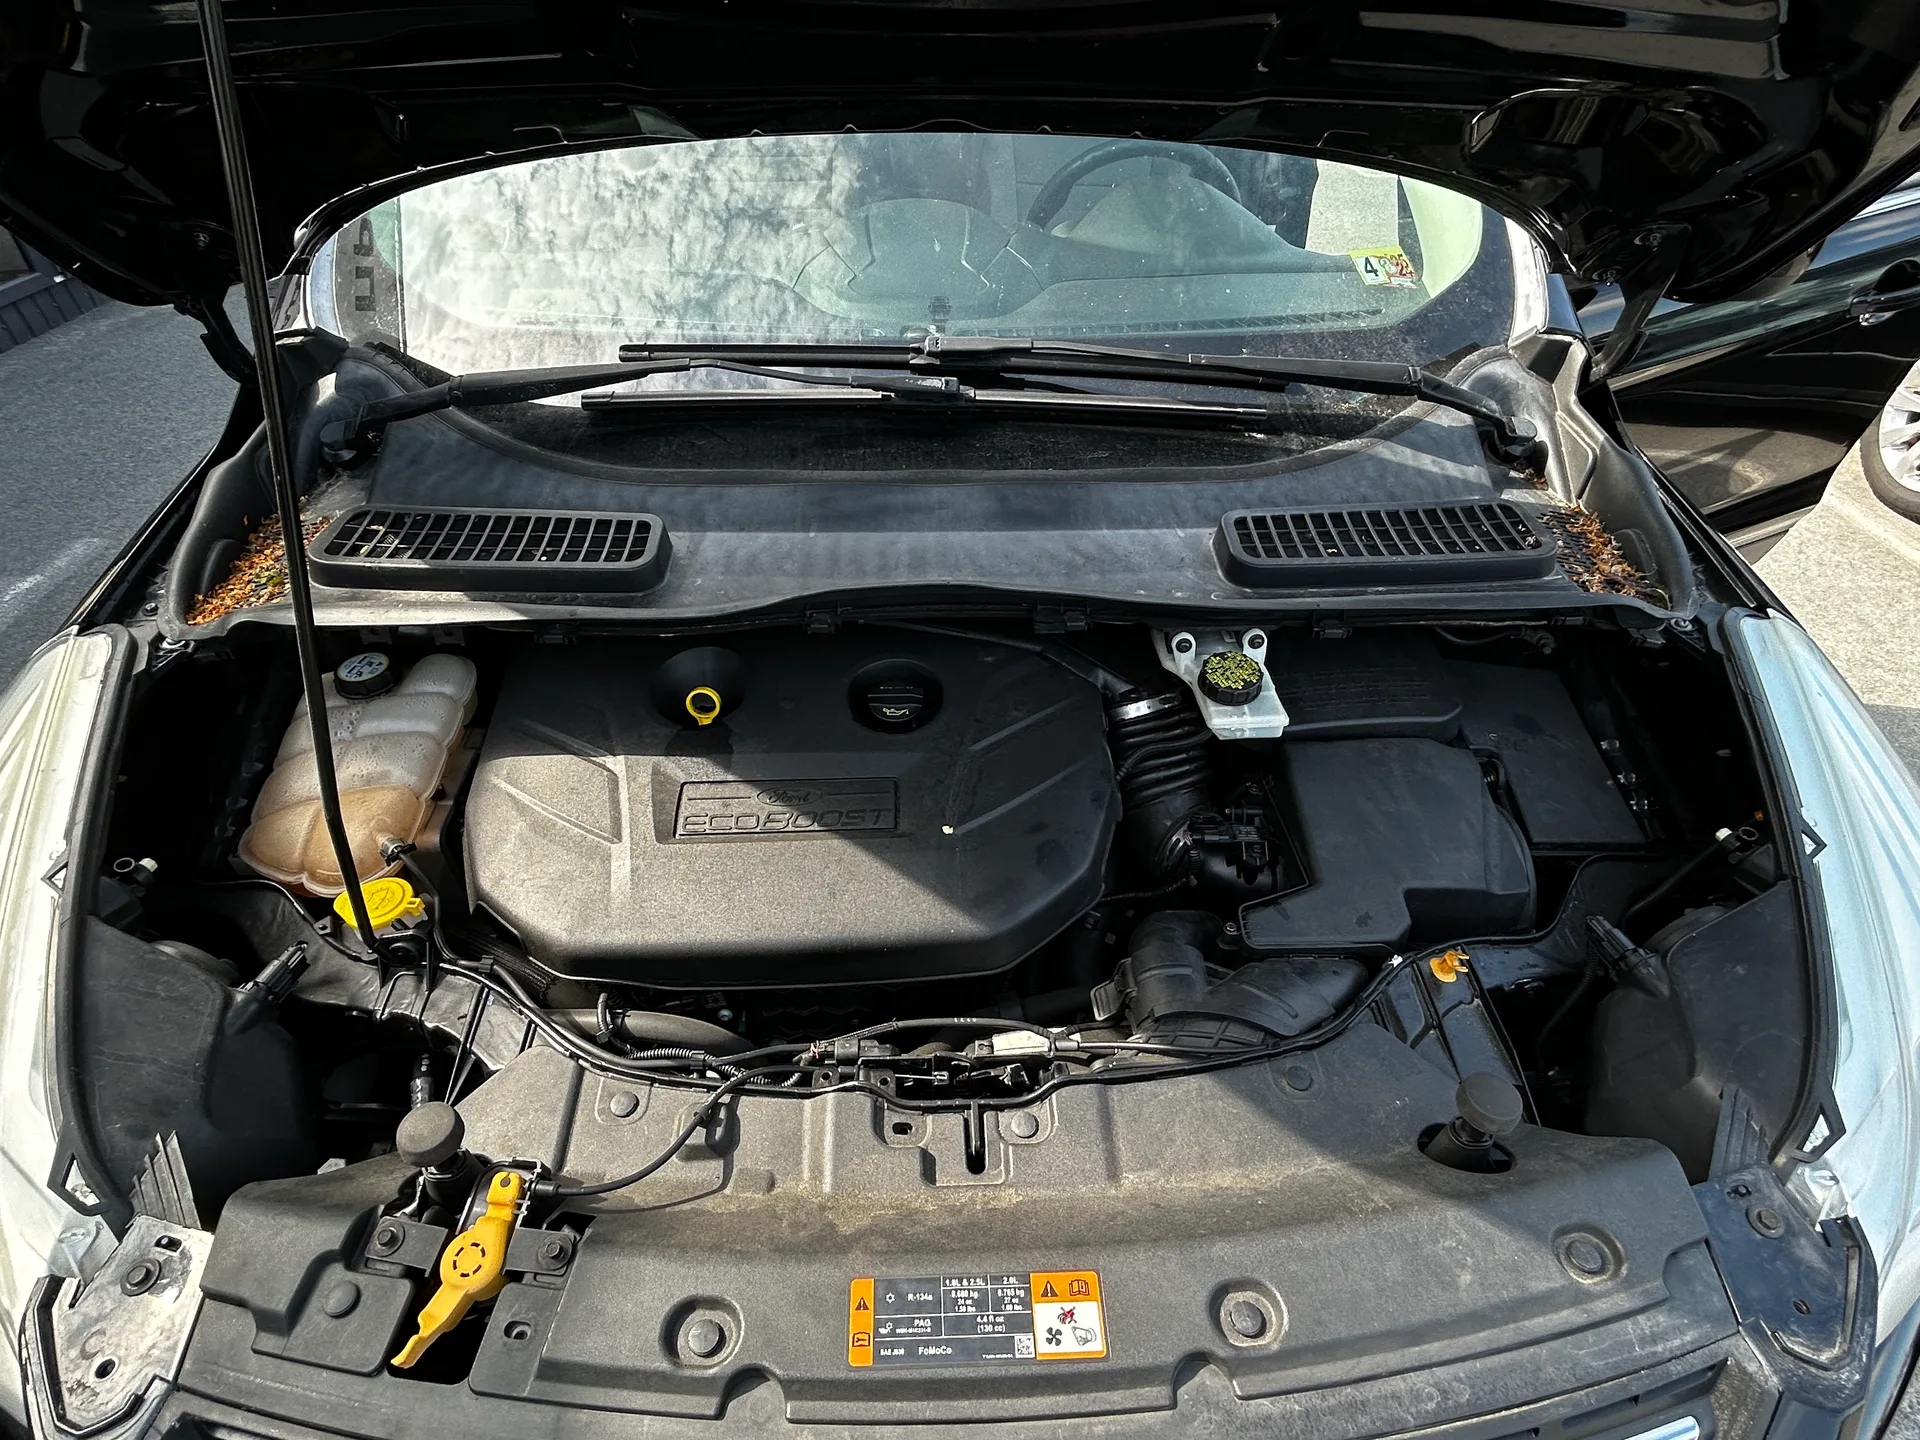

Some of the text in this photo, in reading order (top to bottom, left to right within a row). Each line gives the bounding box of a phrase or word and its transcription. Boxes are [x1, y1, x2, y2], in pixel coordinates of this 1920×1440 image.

[1365, 256, 1379, 277] 4
[767, 788, 811, 804] Ford
[681, 807, 893, 833] ECOBOOST
[907, 1293, 933, 1301] R-134a
[1015, 1288, 1025, 1298] kg
[914, 1319, 932, 1327] PAG
[976, 1315, 988, 1323] 4.4
[977, 1323, 1006, 1333] (130 cc)
[918, 1346, 952, 1356] FoMoCo
